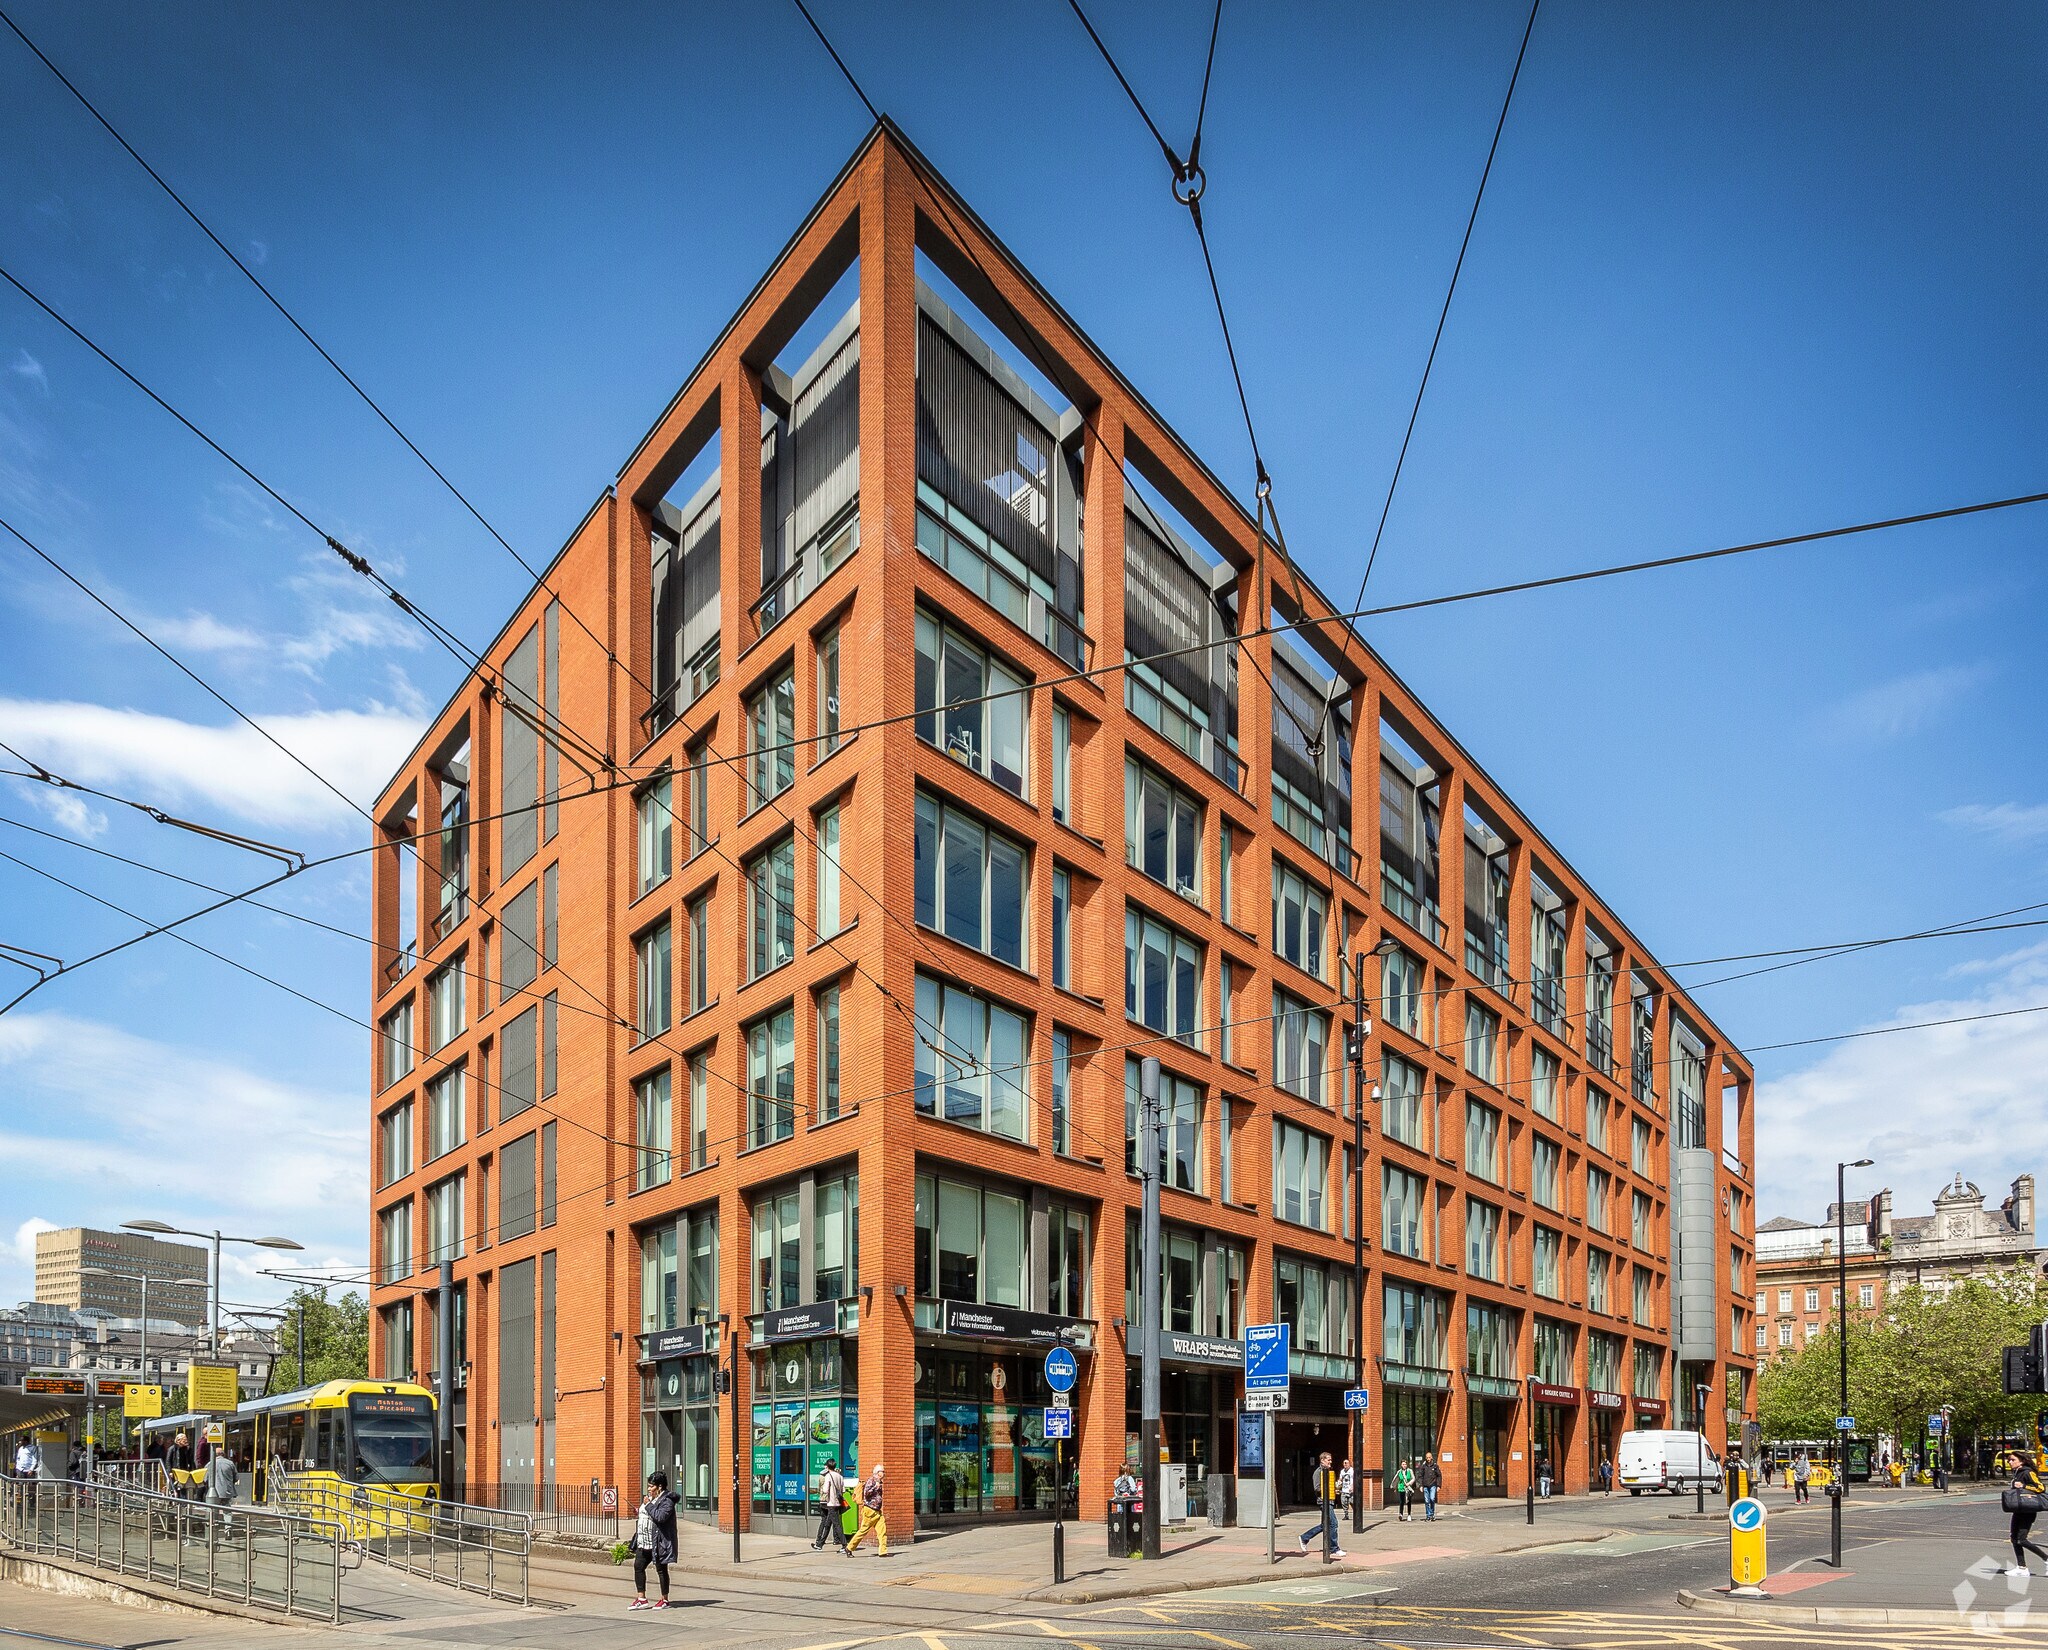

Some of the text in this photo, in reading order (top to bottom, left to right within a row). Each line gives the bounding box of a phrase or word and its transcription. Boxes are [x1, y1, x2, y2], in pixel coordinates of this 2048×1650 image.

[784, 1315, 810, 1325] Manchester
[959, 1313, 993, 1323] Manchester
[959, 1321, 971, 1329] Visitor
[972, 1323, 993, 1331] Information
[1172, 1339, 1209, 1356] WRAPS
[1054, 1396, 1068, 1405] Only
[785, 1480, 798, 1488] BOOK
